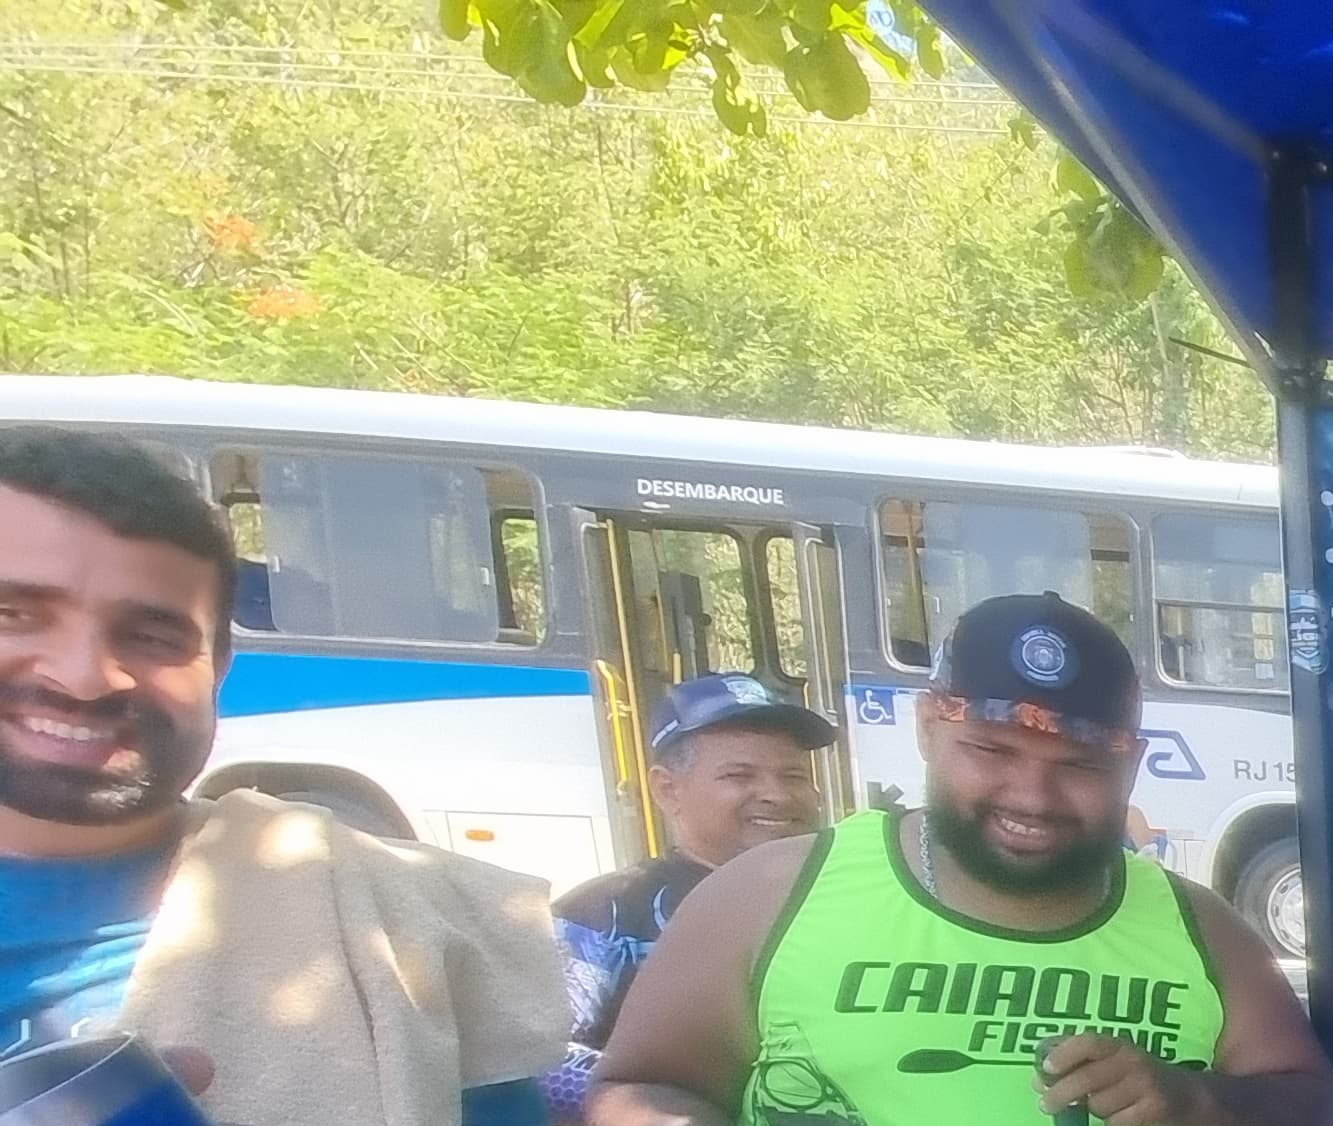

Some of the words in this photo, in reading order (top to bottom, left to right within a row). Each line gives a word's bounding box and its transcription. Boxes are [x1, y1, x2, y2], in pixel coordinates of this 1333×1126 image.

[637, 478, 784, 505] DESEMBARQUE
[1233, 759, 1268, 782] RJ
[834, 961, 1189, 1029] CAIAQUE
